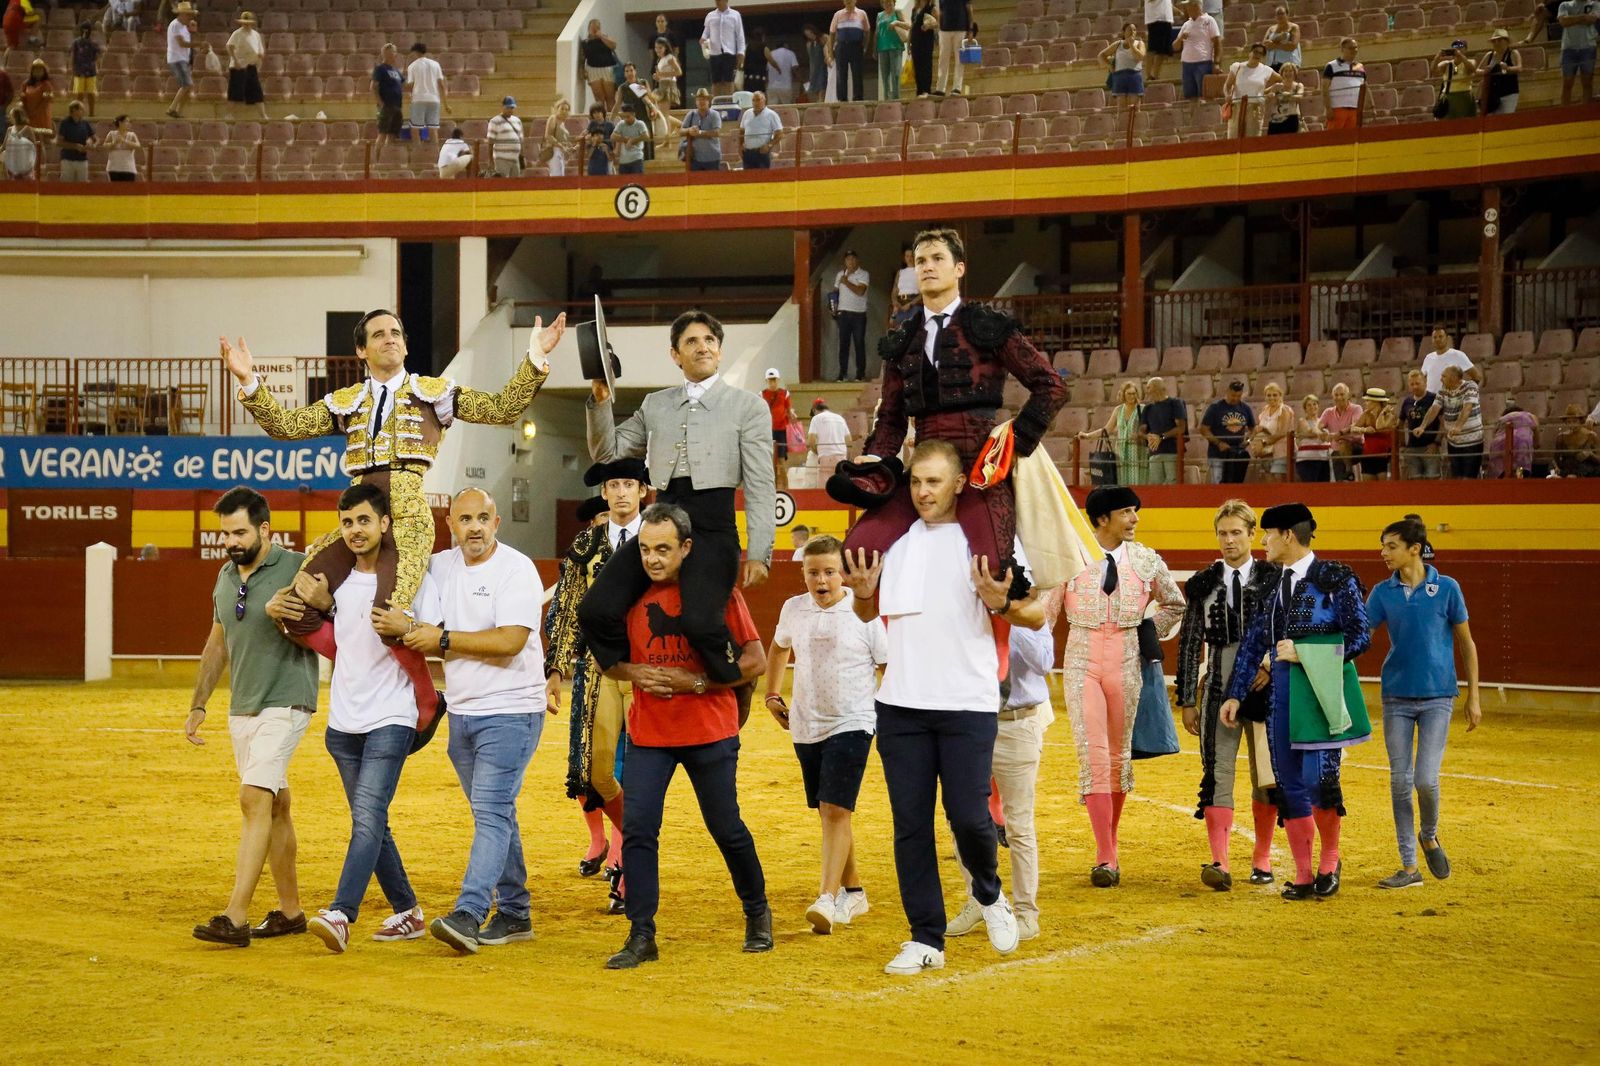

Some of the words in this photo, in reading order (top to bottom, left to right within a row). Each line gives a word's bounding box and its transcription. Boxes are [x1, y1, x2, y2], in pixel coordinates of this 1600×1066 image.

[624, 191, 639, 214] 6
[251, 364, 293, 373] ARINES
[261, 375, 268, 383] Y
[173, 455, 205, 482] de
[21, 505, 118, 520] TORILES
[775, 497, 786, 520] 6
[648, 651, 695, 664] ESPAÑA
